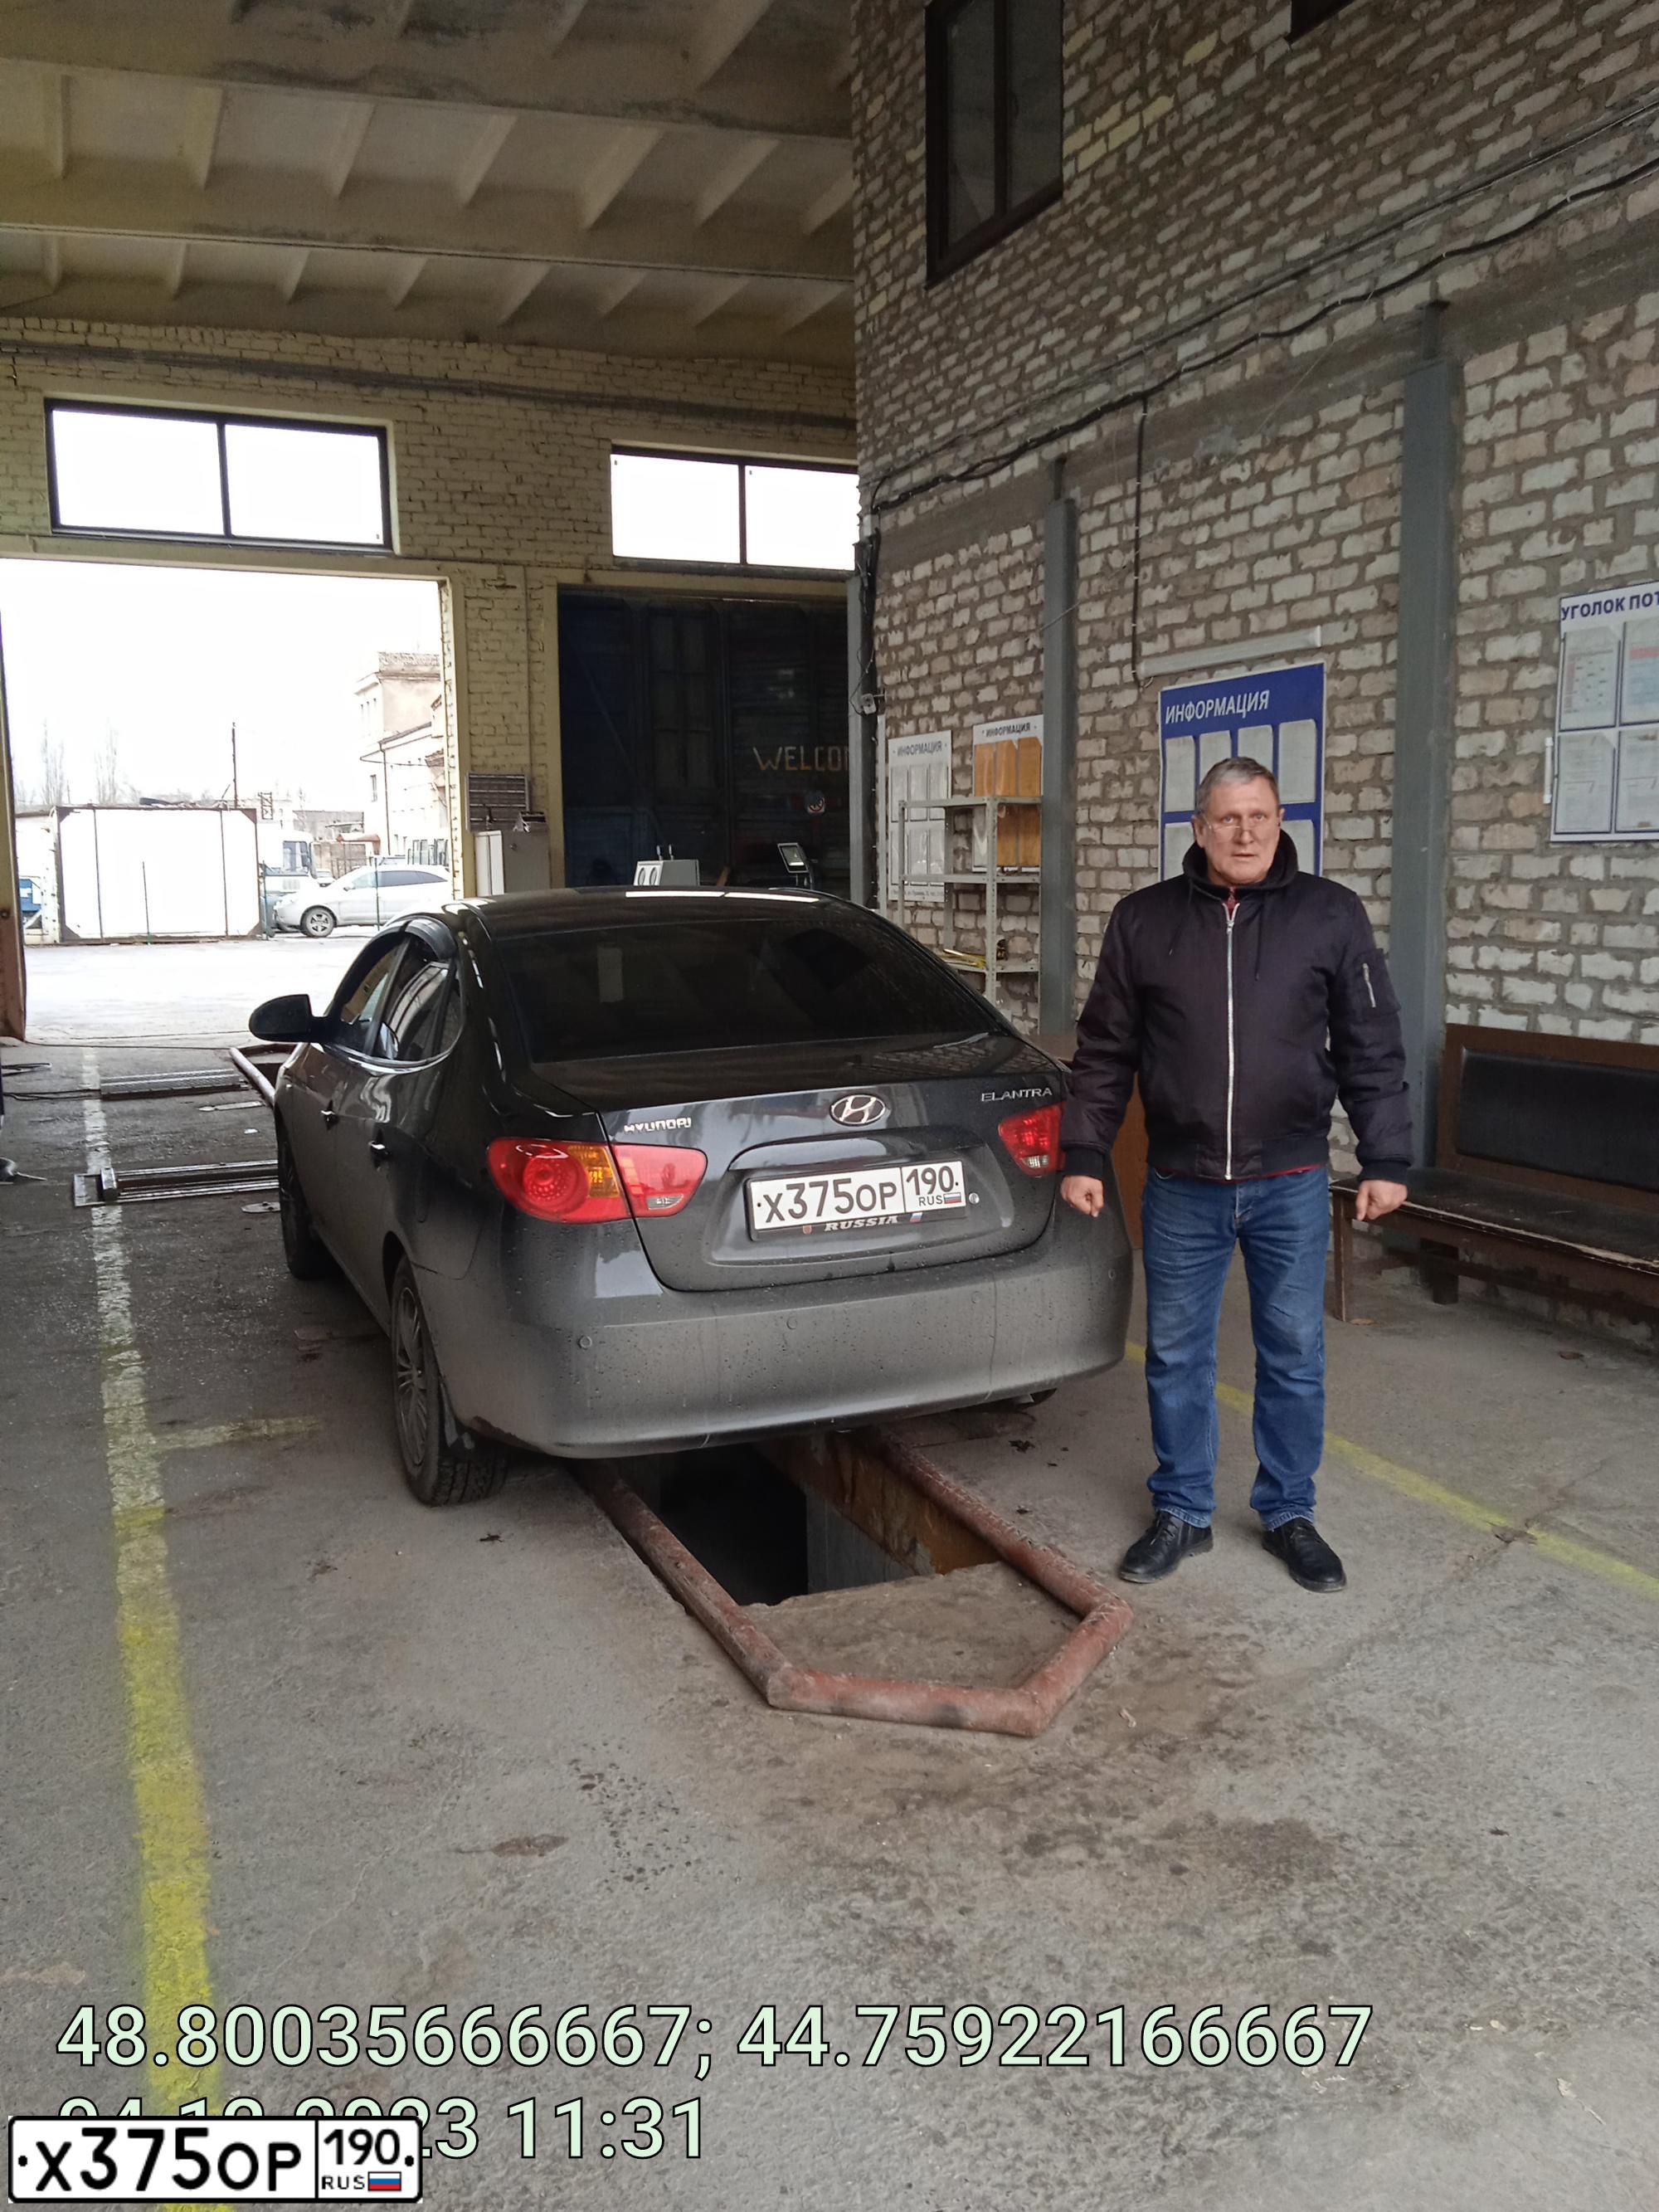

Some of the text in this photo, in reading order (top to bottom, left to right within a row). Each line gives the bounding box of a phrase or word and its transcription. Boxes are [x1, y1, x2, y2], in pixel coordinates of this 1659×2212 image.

[1561, 597, 1626, 621] УГОЛОК
[1165, 689, 1270, 724] ИНФОРМАЦИЯ
[985, 722, 1030, 738] ИНФОРМАЦИЯ
[897, 740, 943, 757] ИНФОРМАЦИЯ
[752, 745, 849, 772] WELCO
[981, 1087, 1053, 1102] ELANTRA
[624, 1117, 691, 1134] HYUNDAI
[906, 1165, 955, 1196] 190
[918, 1195, 943, 1206] RUS
[824, 1215, 898, 1232] RUSSIA
